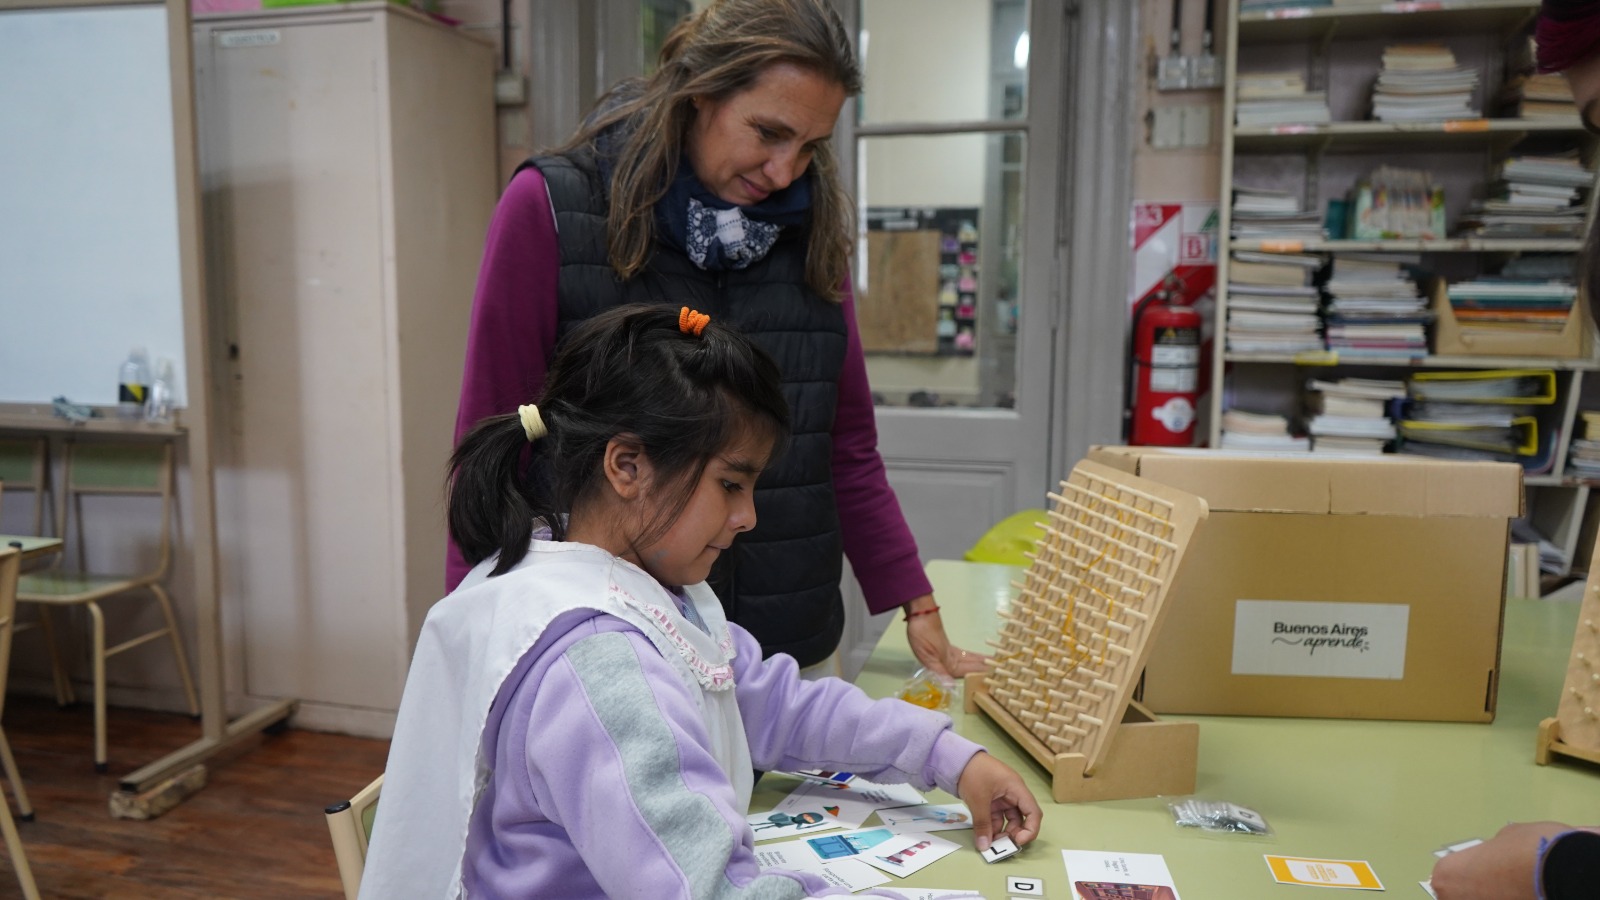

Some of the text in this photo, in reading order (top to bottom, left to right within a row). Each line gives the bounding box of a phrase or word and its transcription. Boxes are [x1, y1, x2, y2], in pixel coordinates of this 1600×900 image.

[1273, 621, 1369, 636] Buenos Aires
[1303, 632, 1364, 656] aprende
[989, 846, 1007, 856] L
[1014, 882, 1035, 891] D
